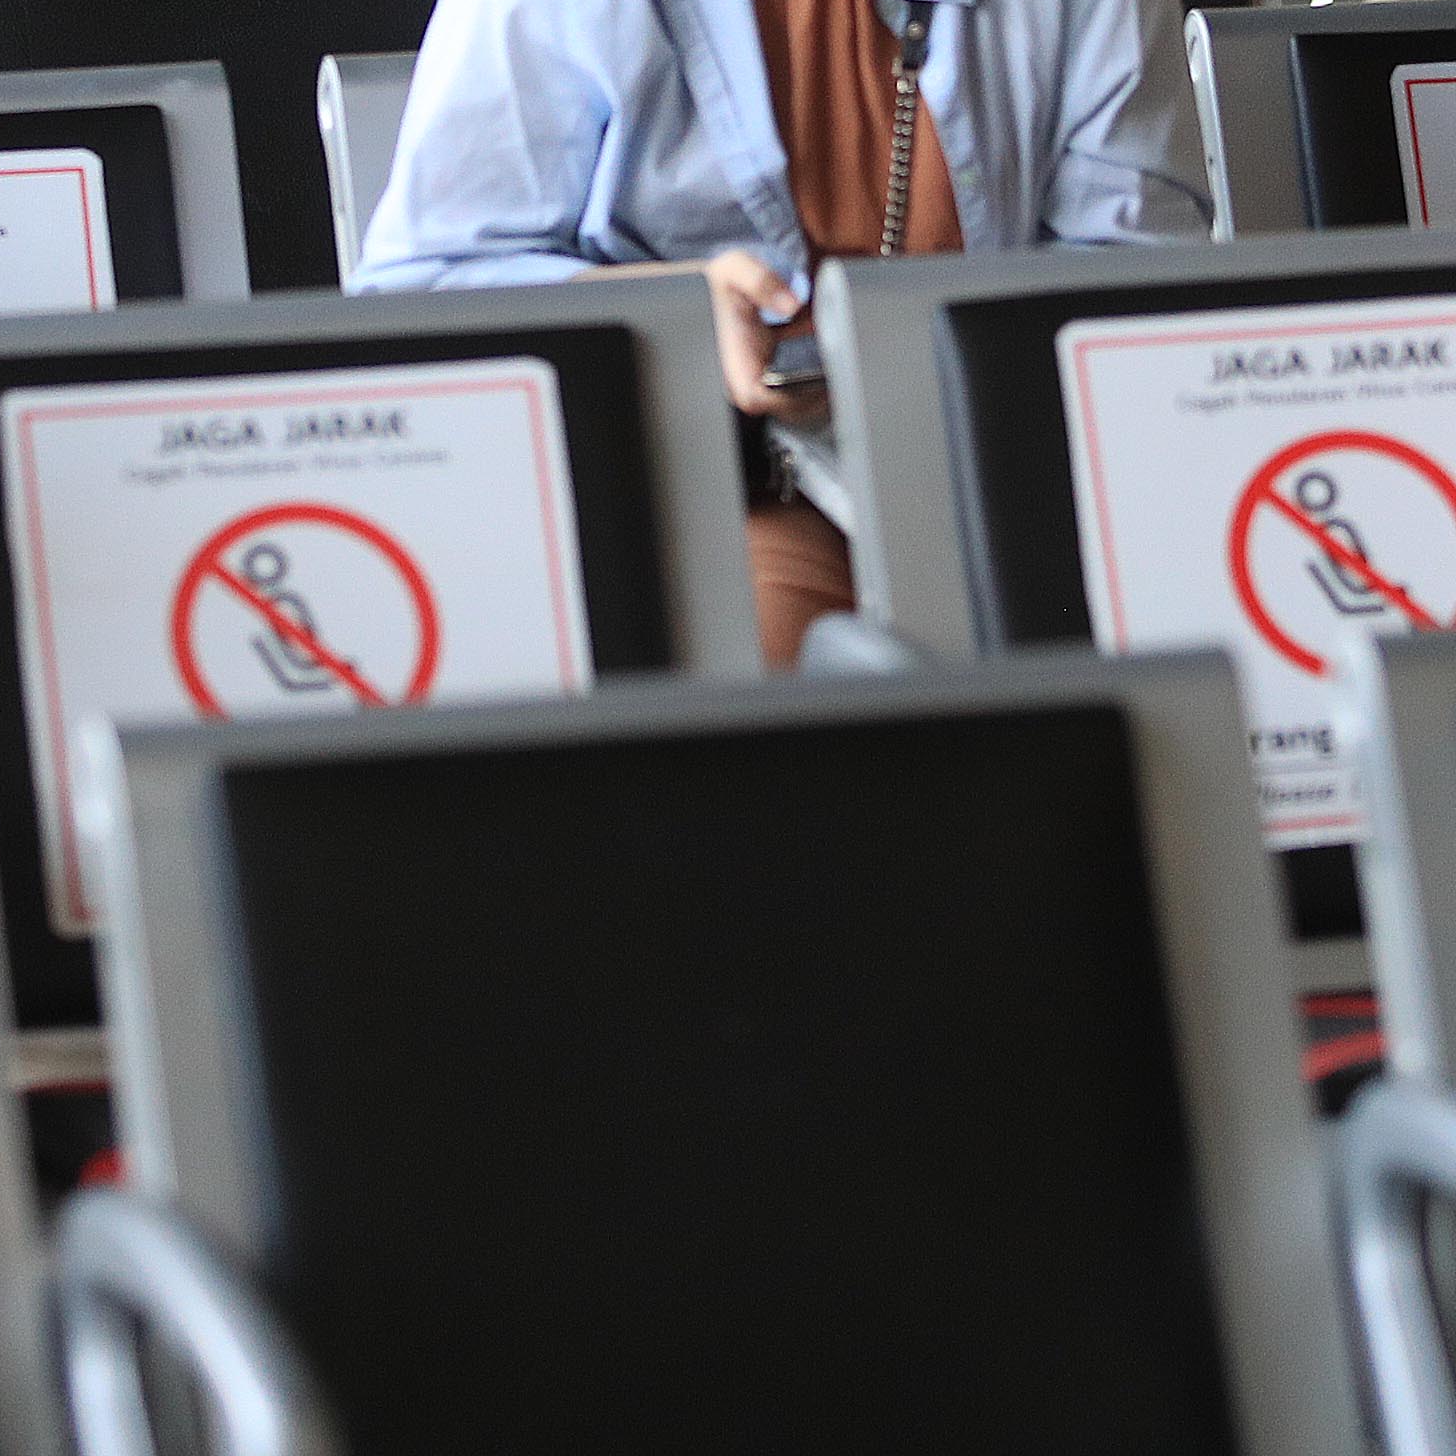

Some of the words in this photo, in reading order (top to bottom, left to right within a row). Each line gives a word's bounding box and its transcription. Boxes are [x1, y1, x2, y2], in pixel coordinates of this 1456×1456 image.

[1208, 346, 1309, 385] JAGA
[1326, 335, 1450, 377] JARAK
[160, 415, 266, 456] JAGA
[284, 404, 408, 444] JARAK
[1249, 723, 1335, 759] rang
